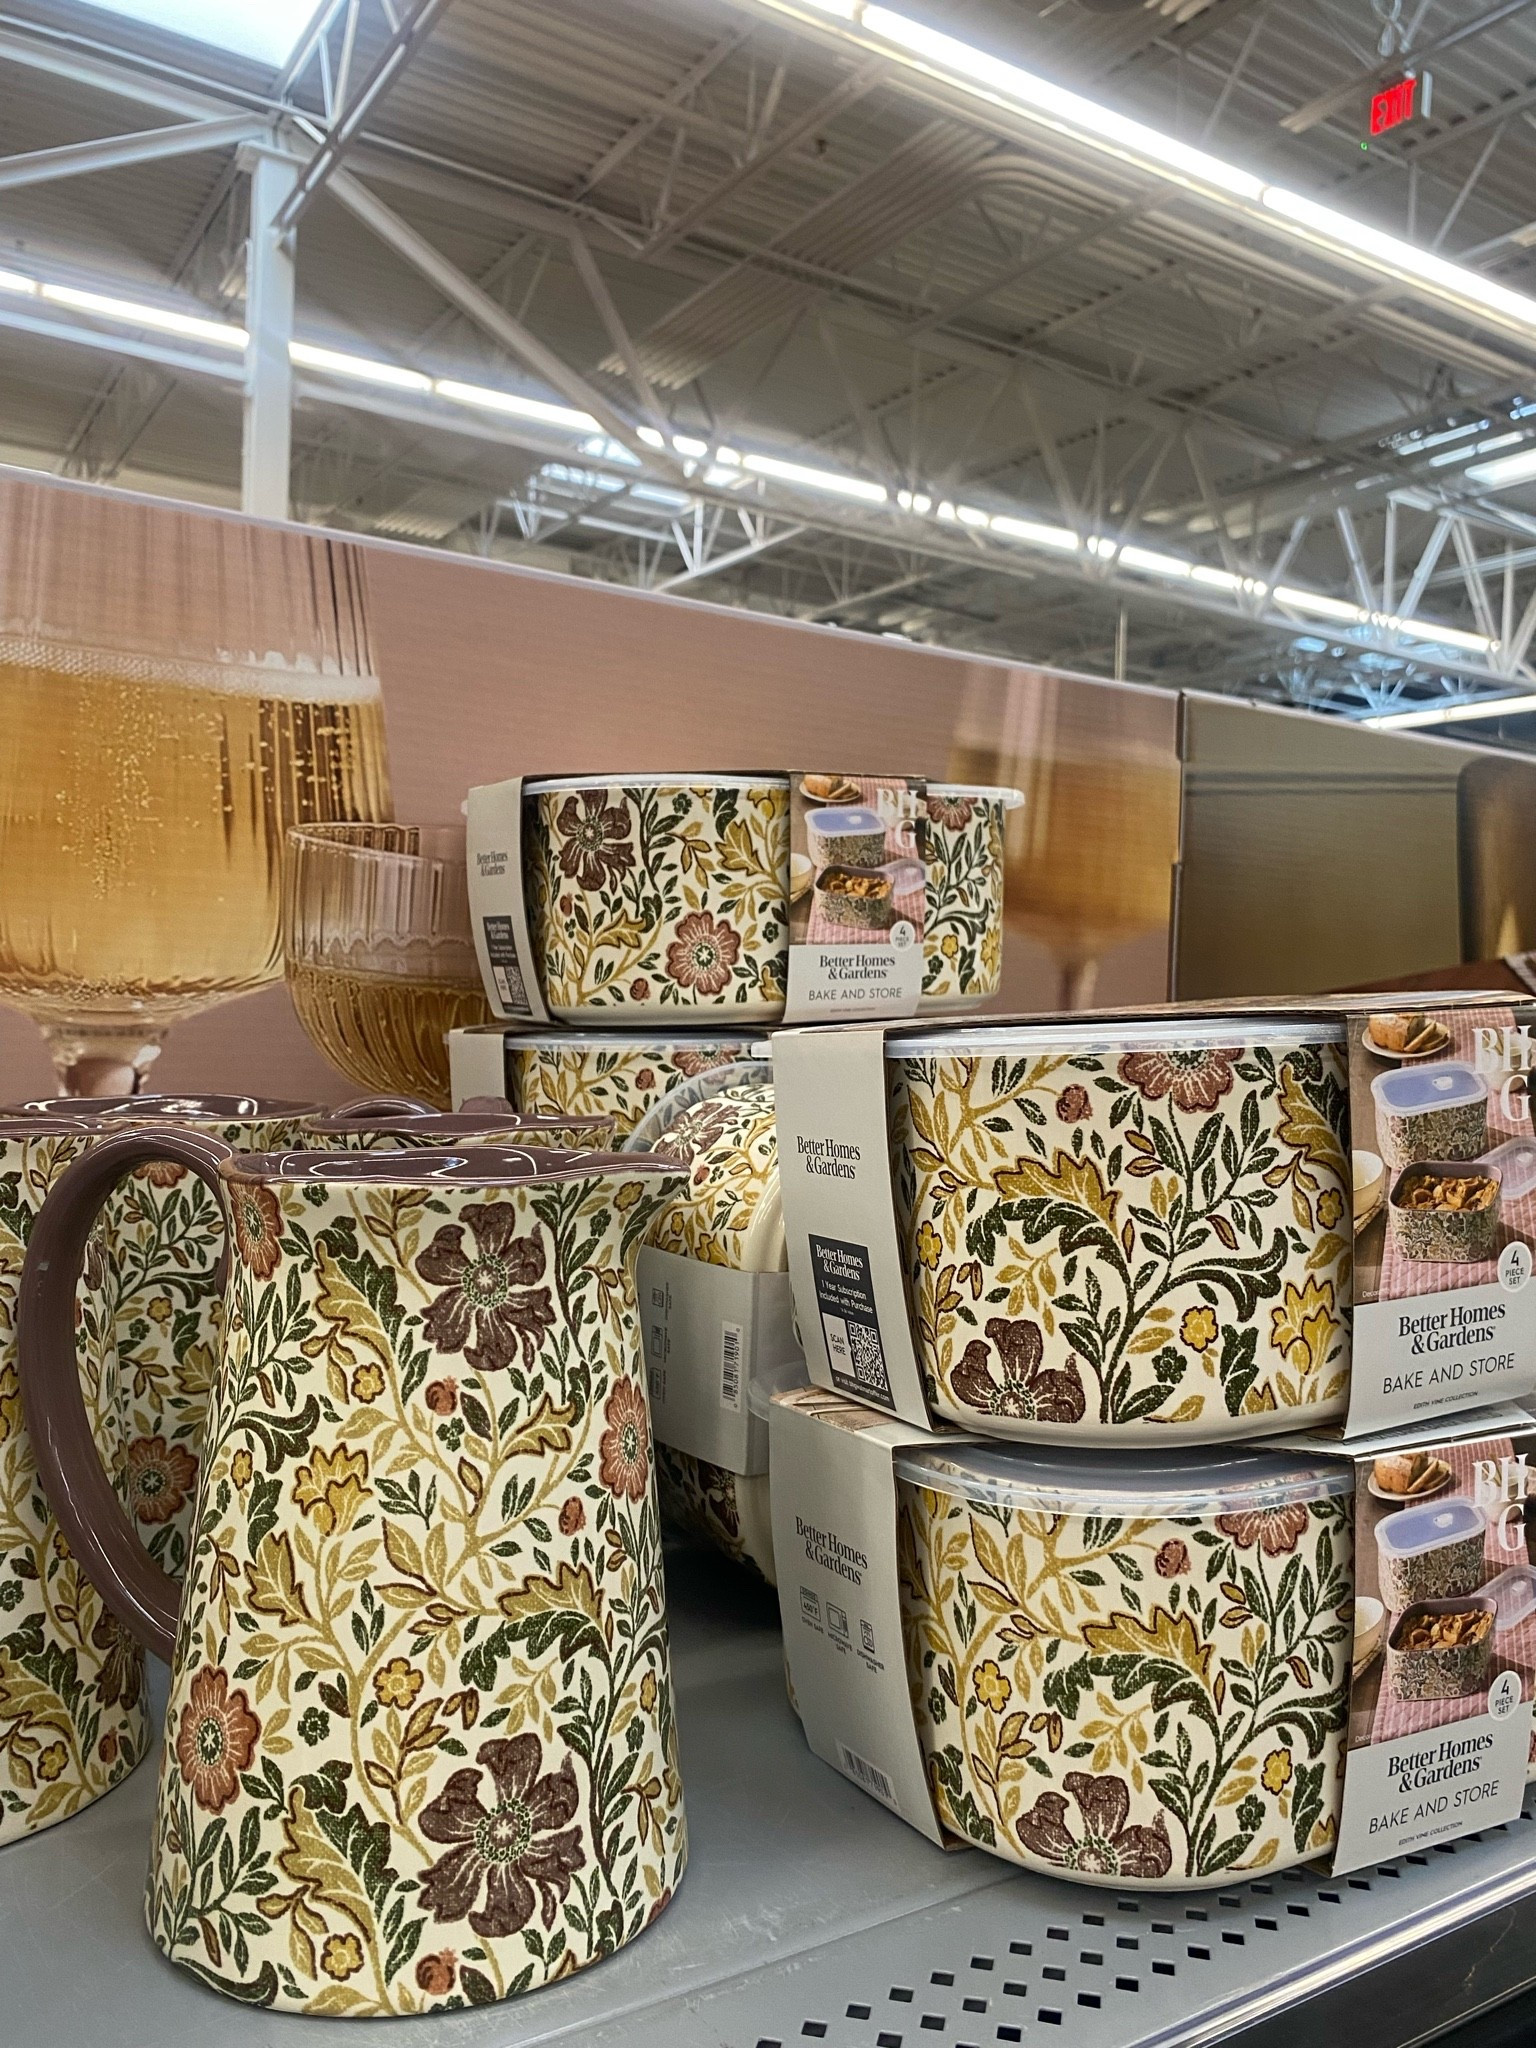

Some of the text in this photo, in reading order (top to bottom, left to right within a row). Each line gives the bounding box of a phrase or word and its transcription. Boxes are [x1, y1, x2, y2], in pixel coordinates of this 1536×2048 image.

[1370, 77, 1418, 136] EXIT
[877, 788, 919, 818] BH
[896, 819, 917, 849] G
[820, 954, 896, 968] Better Homes
[828, 966, 887, 980] & Gardens
[808, 987, 902, 1001] BAKE AND STORE
[1471, 1024, 1532, 1075] BH
[1501, 1074, 1532, 1122] G
[797, 1135, 861, 1160] Better Homes
[806, 1154, 855, 1180] & Gardens
[816, 1243, 864, 1268] Better Homes
[1510, 1250, 1519, 1266] 4
[823, 1259, 860, 1281] & Gardens
[1505, 1267, 1525, 1278] PIECE
[1509, 1276, 1520, 1285] SET
[1399, 1303, 1506, 1337] Better Homes
[1411, 1325, 1494, 1355] & Gardens
[1383, 1353, 1515, 1394] BAKE AND STORE
[1445, 1391, 1478, 1403] COLLECTION
[1472, 1453, 1529, 1508] BH
[1497, 1503, 1527, 1551] G
[795, 1515, 868, 1569] Better Homes
[805, 1540, 861, 1586] & Gardens
[1495, 1695, 1513, 1707] PIECE
[1501, 1679, 1510, 1695] 4
[1498, 1705, 1509, 1714] SET
[1387, 1733, 1494, 1777] Better Homes
[1399, 1756, 1480, 1793] & Gardens
[1369, 1780, 1499, 1834] BAKE AND STORE
[1430, 1821, 1463, 1836] COLLECTION
